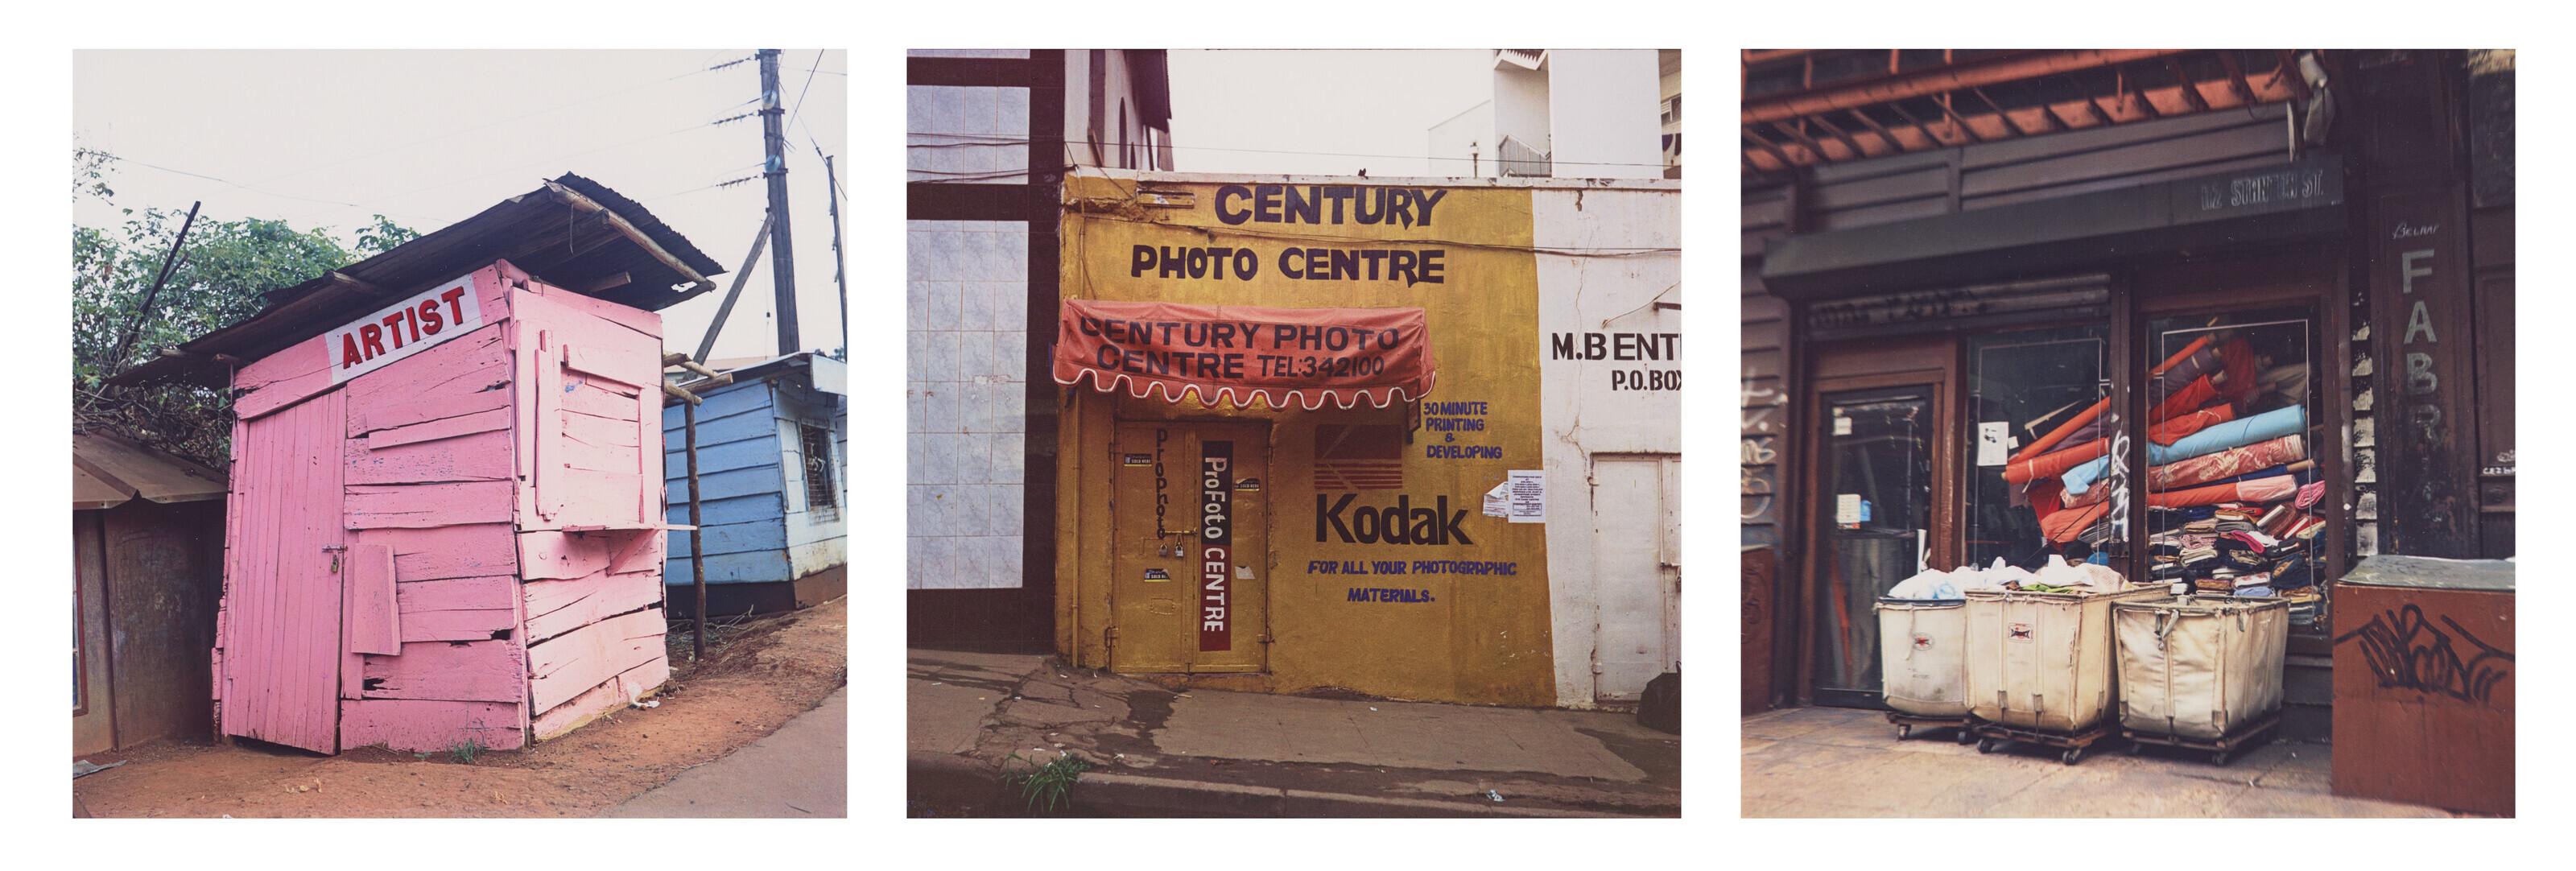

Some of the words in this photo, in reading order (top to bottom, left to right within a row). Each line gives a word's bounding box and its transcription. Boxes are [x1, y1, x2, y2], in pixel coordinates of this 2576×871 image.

[1215, 184, 1447, 230] CENTURY
[1131, 244, 1258, 281] PHOTO
[1278, 246, 1444, 288] CENTRE
[343, 286, 464, 369] ARTIST
[1080, 316, 1260, 349] CENTURY
[1274, 324, 1399, 352] PHOTO
[1096, 343, 1245, 378] CENTRE
[1551, 332, 1607, 360] M.B
[1613, 333, 1682, 361] ENT
[1423, 402, 1439, 415] 30
[1440, 401, 1488, 415] MINUTE
[1426, 417, 1484, 431] PRINTING
[1426, 444, 1502, 460] DEVELOPING
[1445, 432, 1455, 442] &
[1204, 457, 1228, 539] ProFoto
[1315, 493, 1474, 546] Kodak
[1307, 560, 1337, 574] FOR
[1341, 560, 1368, 574] ALL
[1372, 560, 1407, 574] YOUR
[1412, 560, 1517, 576] PHOTOGRAPHIC
[1203, 547, 1226, 632] CENTRE
